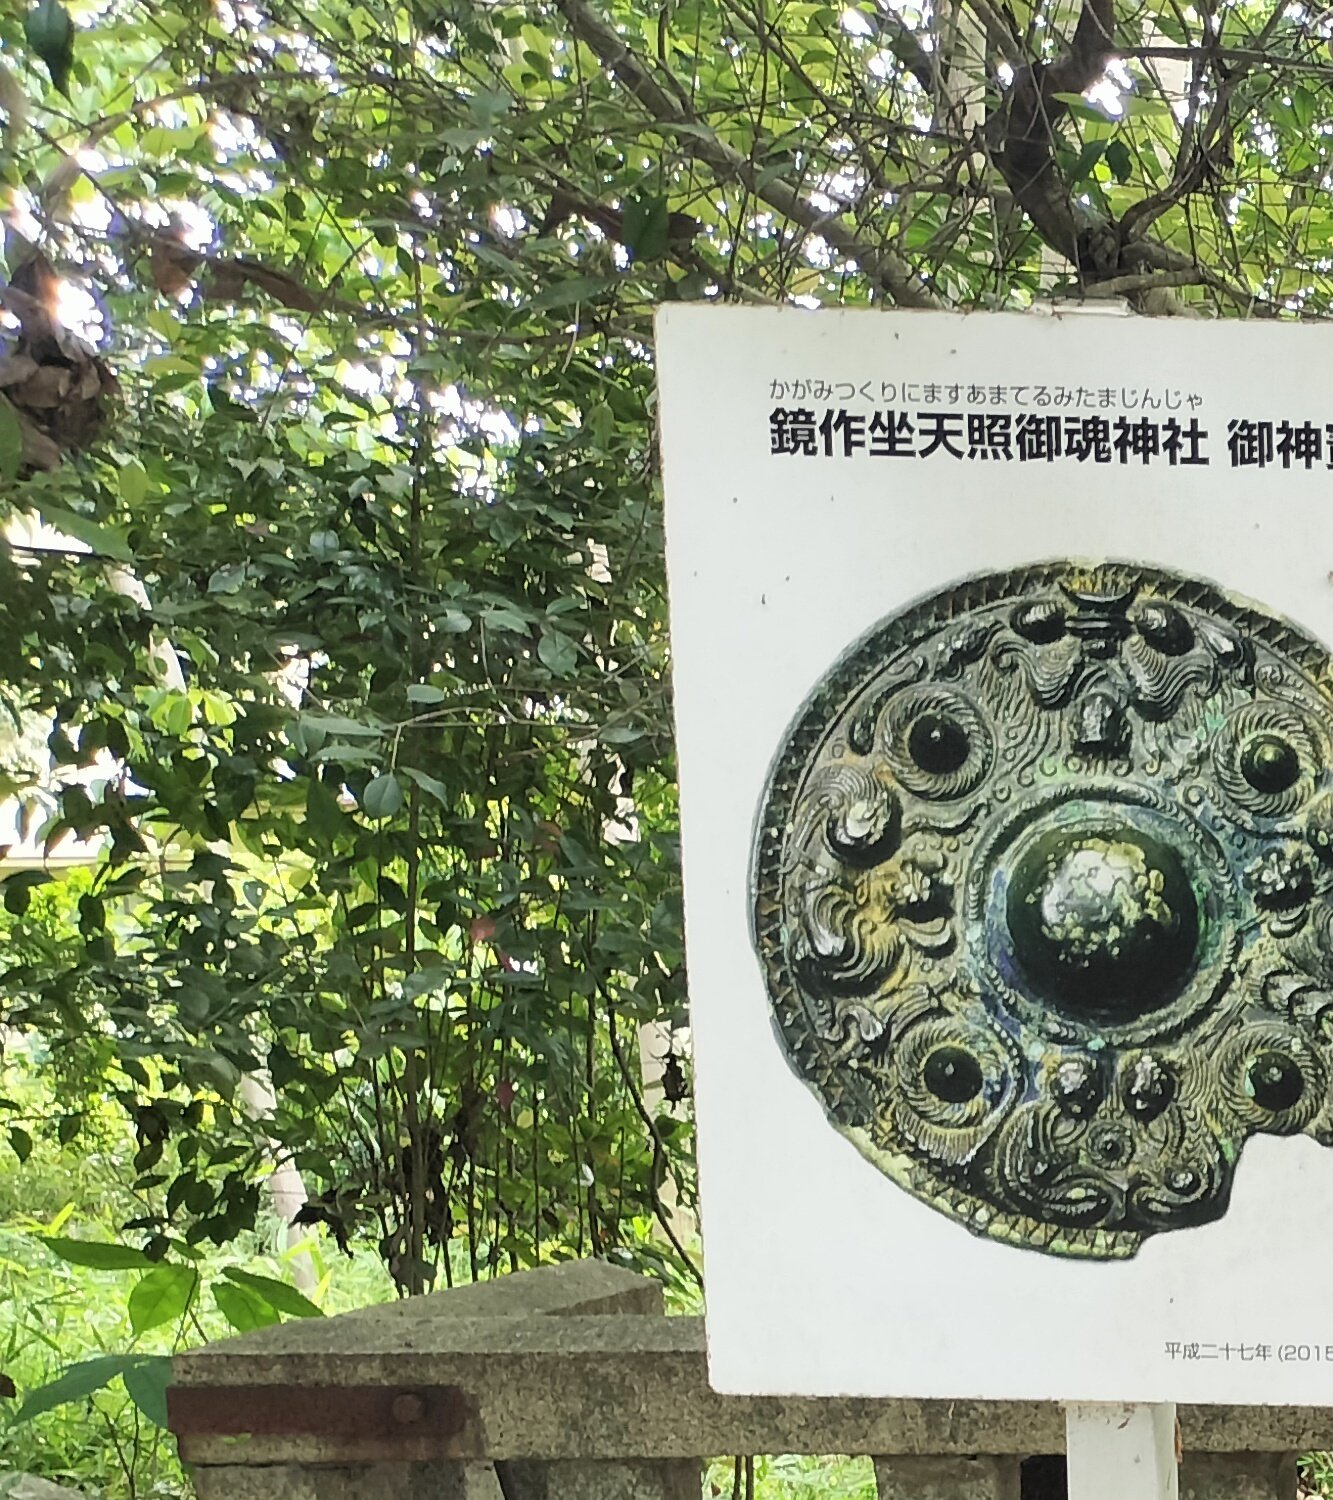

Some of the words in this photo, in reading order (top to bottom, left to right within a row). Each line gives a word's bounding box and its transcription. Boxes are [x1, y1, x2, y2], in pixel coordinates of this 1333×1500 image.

[768, 377, 1203, 410] かがみつくりにますあまてるみたまじんじゃ
[768, 406, 1210, 466] 鏡作坐天照御魂神社
[1163, 1341, 1273, 1362] 平成二十七年
